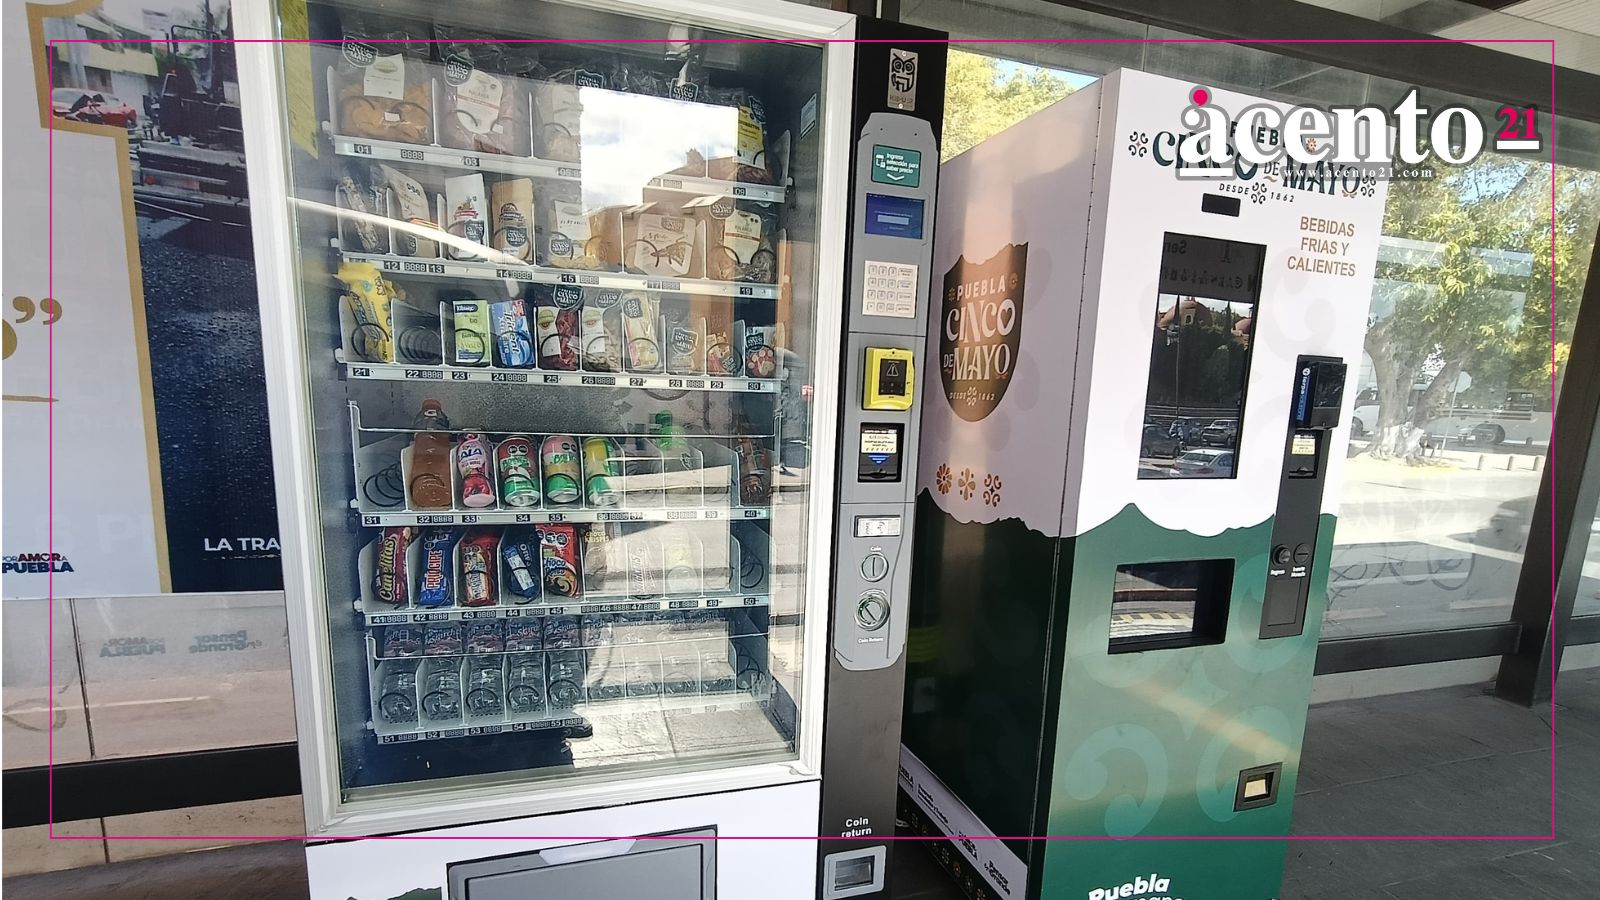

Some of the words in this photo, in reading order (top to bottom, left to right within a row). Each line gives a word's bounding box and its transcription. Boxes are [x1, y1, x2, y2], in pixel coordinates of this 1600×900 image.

[464, 158, 478, 166] 03
[1219, 183, 1250, 195] DESDE
[1270, 192, 1295, 203] 1862
[1300, 216, 1355, 237] BEBIDAS
[1301, 237, 1338, 255] FRIAS
[1342, 242, 1350, 256] Y
[386, 262, 398, 270] 12
[430, 264, 442, 272] 13
[498, 270, 509, 278] 14
[562, 274, 574, 282] 15
[1287, 256, 1356, 277] CALIENTES
[957, 275, 1006, 301] PUEBLA
[946, 299, 1016, 343] CINCO
[504, 310, 522, 353] Trident
[943, 354, 954, 368] DE
[952, 343, 1010, 380] MAYO
[354, 368, 367, 376] 21
[366, 516, 378, 524] 31
[204, 538, 233, 551] LA
[236, 538, 281, 551] TRA
[18, 553, 61, 562] AMOR
[2, 562, 74, 574] PUEBLA
[380, 536, 397, 601] Canelitas
[846, 817, 869, 828] Coin
[842, 828, 872, 838] return
[1088, 874, 1170, 900] Puebla
